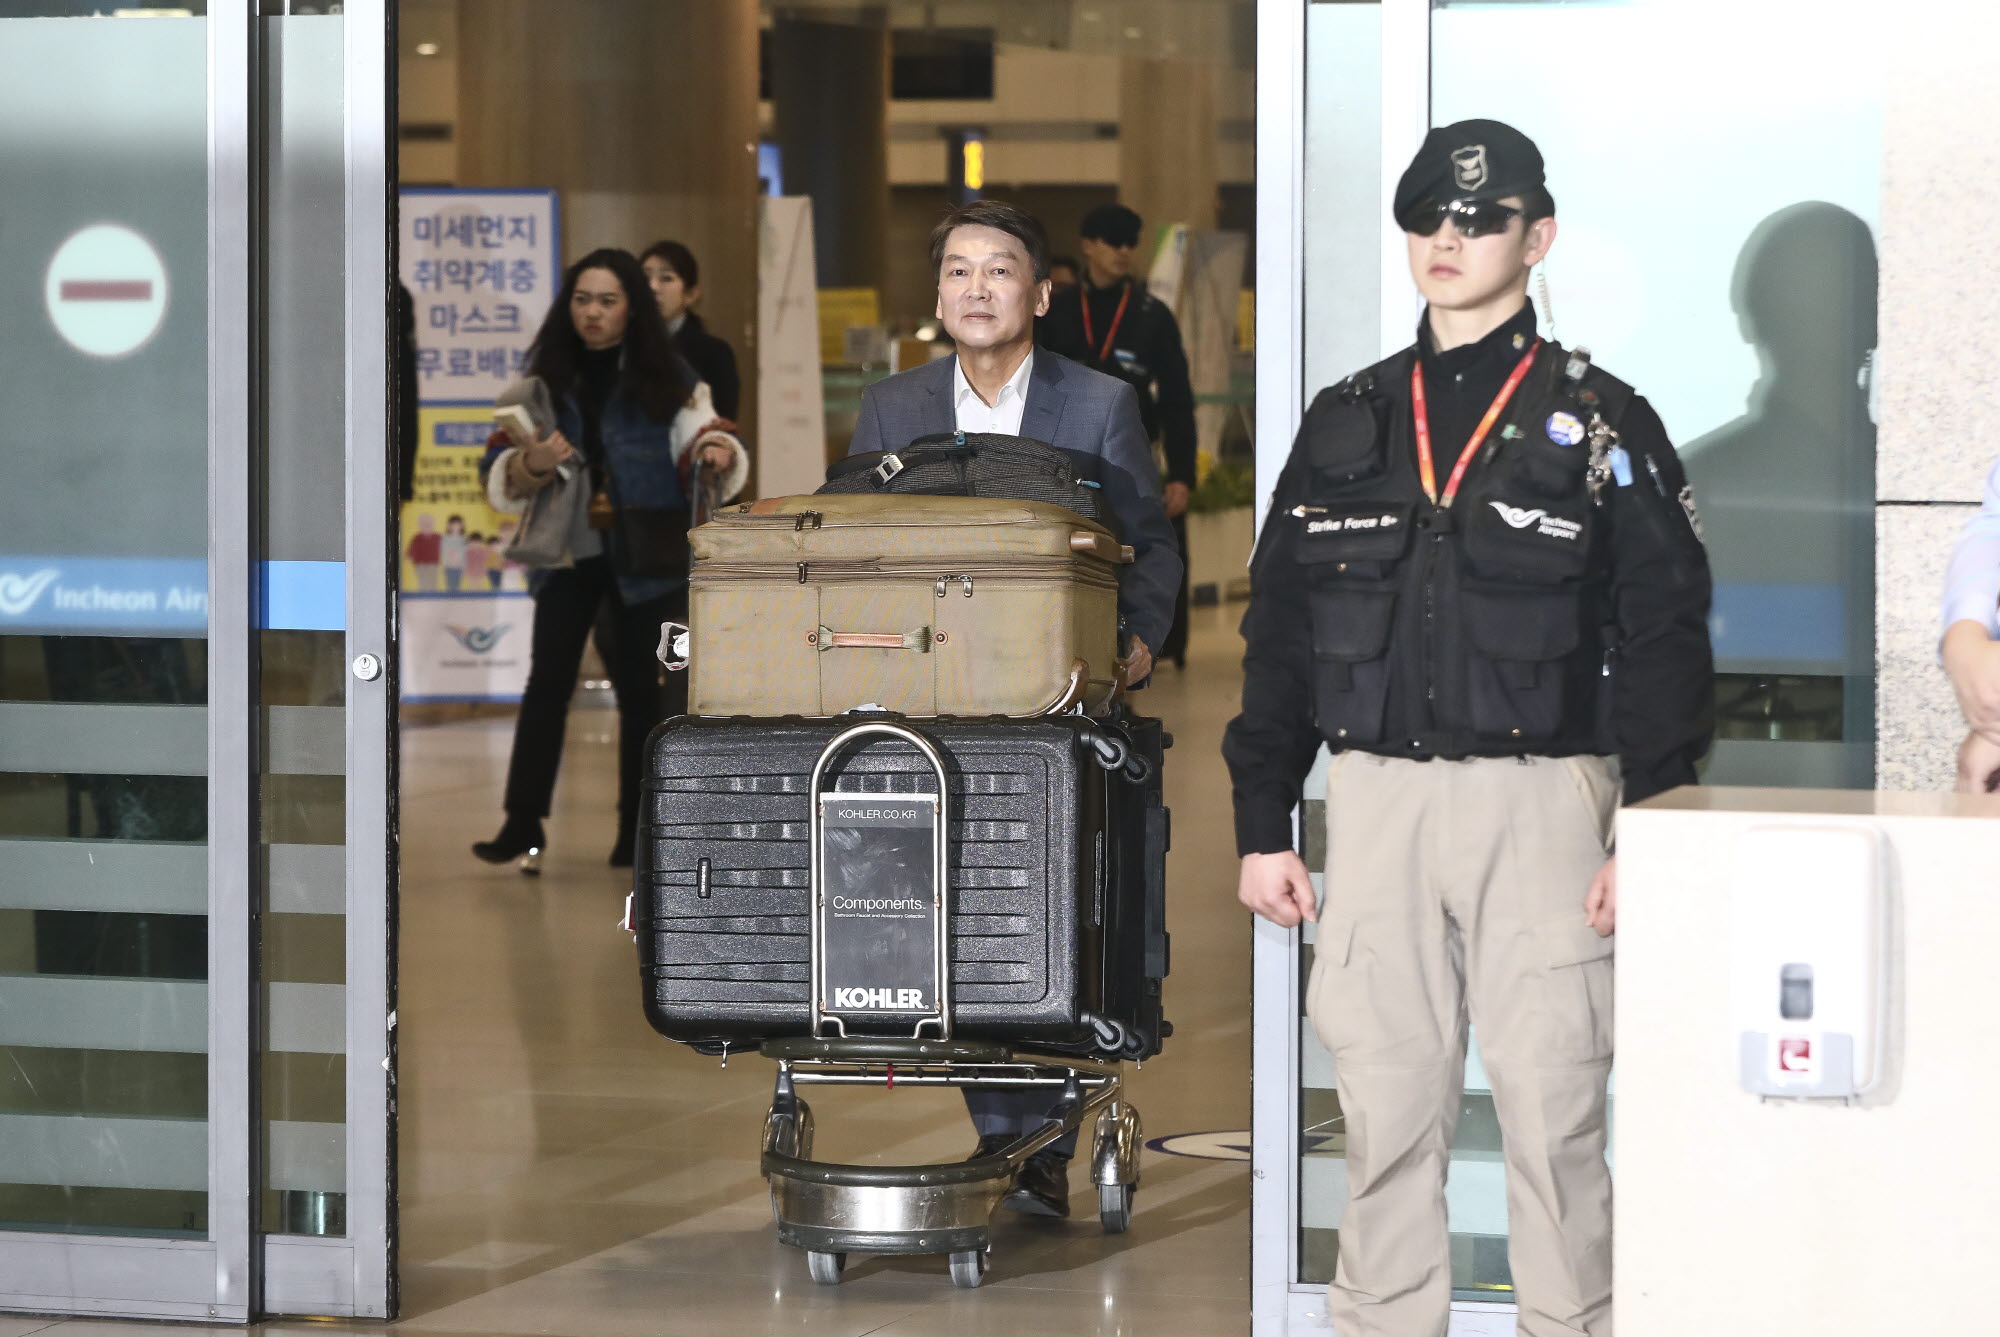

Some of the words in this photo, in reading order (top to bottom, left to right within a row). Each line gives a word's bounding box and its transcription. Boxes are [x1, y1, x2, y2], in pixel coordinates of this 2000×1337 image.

[413, 214, 537, 248] 미세먼지
[414, 258, 539, 293] 취약계층
[430, 304, 522, 336] 마스크
[1306, 519, 1343, 534] Strike
[1343, 517, 1379, 530] Force
[1537, 525, 1577, 540] Airport
[1540, 516, 1583, 532] Incheon
[54, 585, 157, 611] Incheon
[838, 809, 917, 819] KOHLER.CO.KR
[835, 987, 925, 1009] KOHLER
